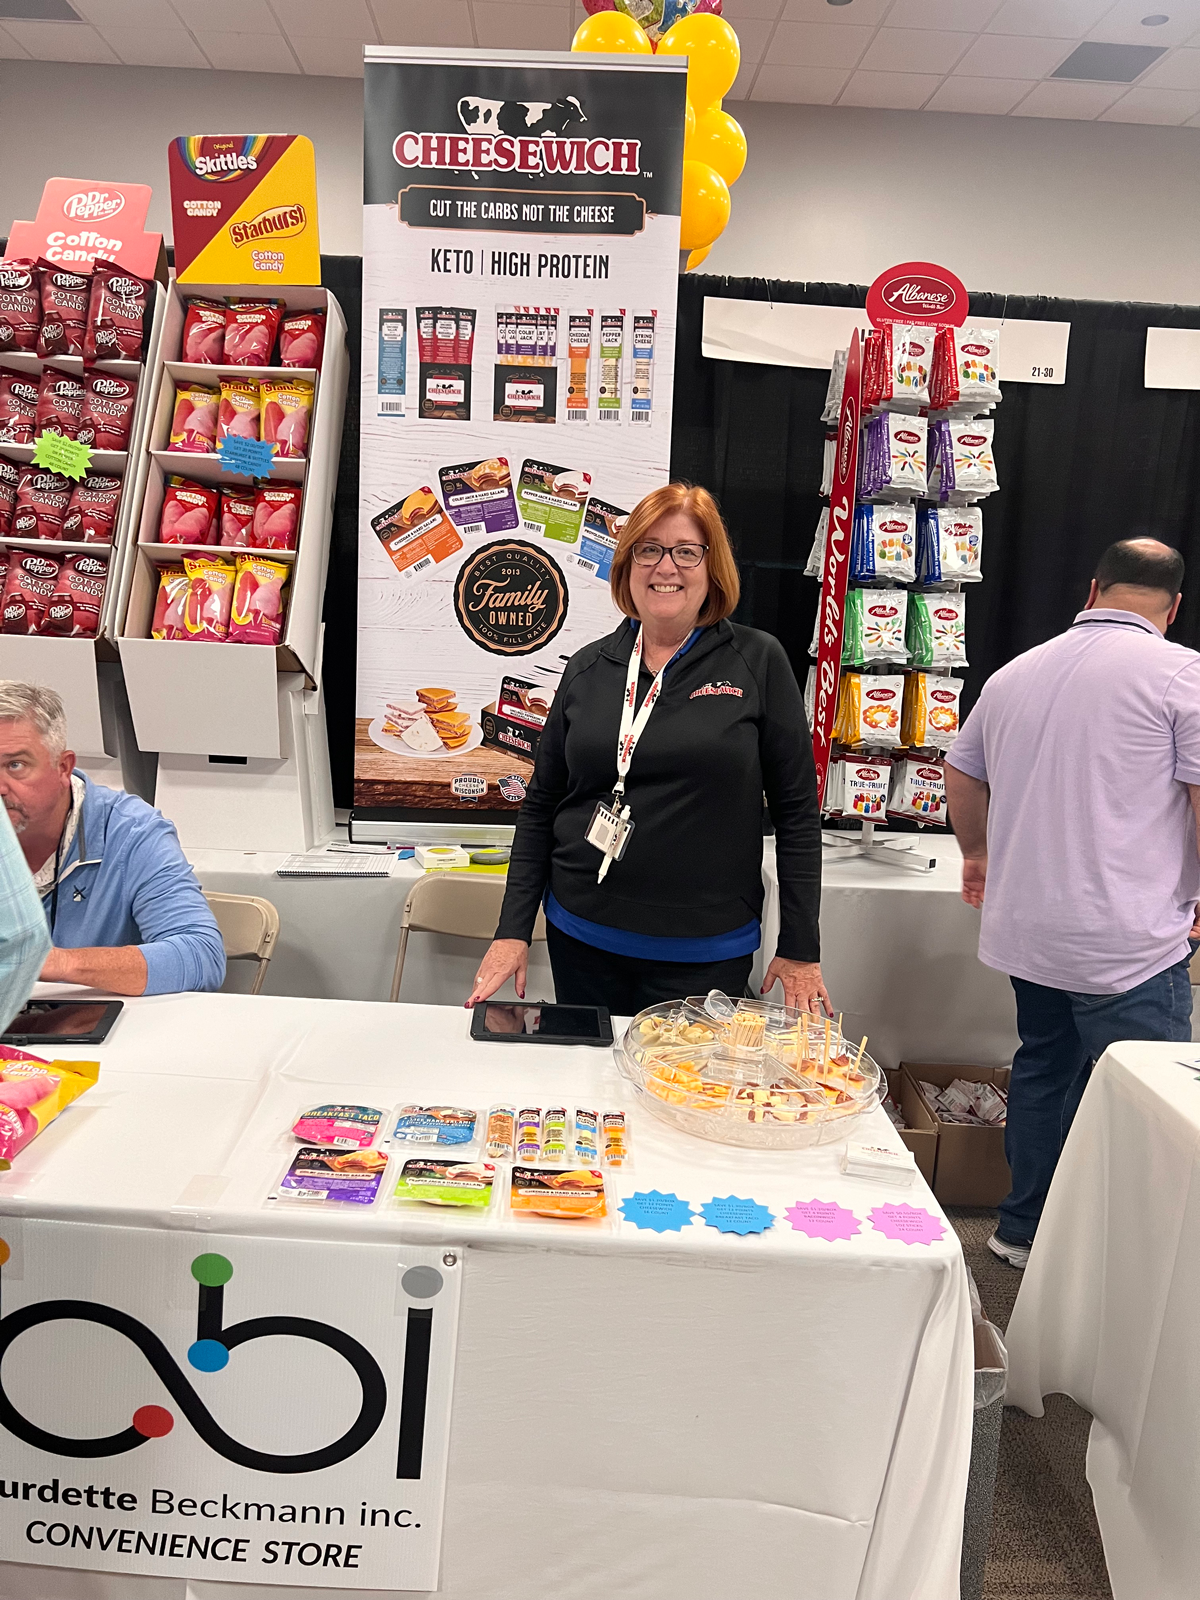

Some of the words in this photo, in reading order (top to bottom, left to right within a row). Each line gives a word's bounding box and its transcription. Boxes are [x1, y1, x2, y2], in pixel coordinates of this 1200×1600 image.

[393, 131, 641, 176] CHEESEWICH
[195, 153, 257, 176] Skittles
[69, 192, 121, 218] Pepper
[87, 191, 109, 204] Dr
[183, 201, 221, 209] COTTON
[187, 208, 218, 217] CANDY
[430, 200, 452, 217] CUT
[456, 201, 477, 218] THE
[481, 202, 518, 220] CARBS
[522, 204, 544, 221] NOT
[548, 205, 570, 222] THE
[574, 206, 615, 223] CHEESE
[231, 206, 305, 243] Starburst
[46, 231, 123, 251] Cotton
[251, 250, 284, 260] Cotton
[253, 261, 284, 273] Candy
[431, 248, 473, 275] KETO
[491, 251, 530, 277] HIGH
[538, 254, 609, 279] PROTEIN
[113, 277, 141, 295] Pepper
[123, 278, 135, 287] Dr
[888, 283, 949, 304] Albanese
[1, 303, 33, 313] CANDY
[106, 296, 144, 313] COTTON
[109, 305, 141, 320] CANDY
[1031, 366, 1054, 378] 21-30
[96, 379, 126, 394] Pepper
[106, 380, 119, 388] Dr
[278, 393, 300, 401] Cotton
[278, 399, 299, 408] Candy
[89, 398, 128, 412] COTTON
[91, 405, 123, 418] CANDY
[842, 406, 854, 476] Albanese
[37, 474, 66, 489] Pepper
[48, 474, 60, 483] Dr
[88, 476, 117, 488] Pepper
[78, 490, 117, 500] COTTON
[79, 496, 111, 504] CANDY
[31, 497, 65, 509] CANDY
[26, 558, 55, 575] Pepper
[37, 558, 50, 566] Dr
[252, 563, 275, 574] Cotton
[474, 556, 497, 577] BEST
[506, 553, 550, 580] QUALITY
[203, 569, 227, 579] Cotton
[252, 569, 274, 580] Candy
[823, 496, 849, 648] World's
[204, 575, 226, 585] Candy
[20, 581, 53, 597] CANDY
[468, 577, 549, 613] Family
[489, 611, 533, 626] OWNED
[479, 624, 499, 641] 100%
[527, 621, 547, 639] RATE
[816, 660, 835, 748] Best
[498, 731, 532, 751] CHEESEWICH
[304, 1111, 357, 1119] BREAKFAST
[358, 1113, 379, 1121] TACO
[0, 1478, 138, 1512] urdette
[150, 1488, 345, 1525] Beckmann
[360, 1501, 422, 1529] inc.
[26, 1520, 250, 1563] CONVENIENCE
[261, 1540, 363, 1568] STORE
